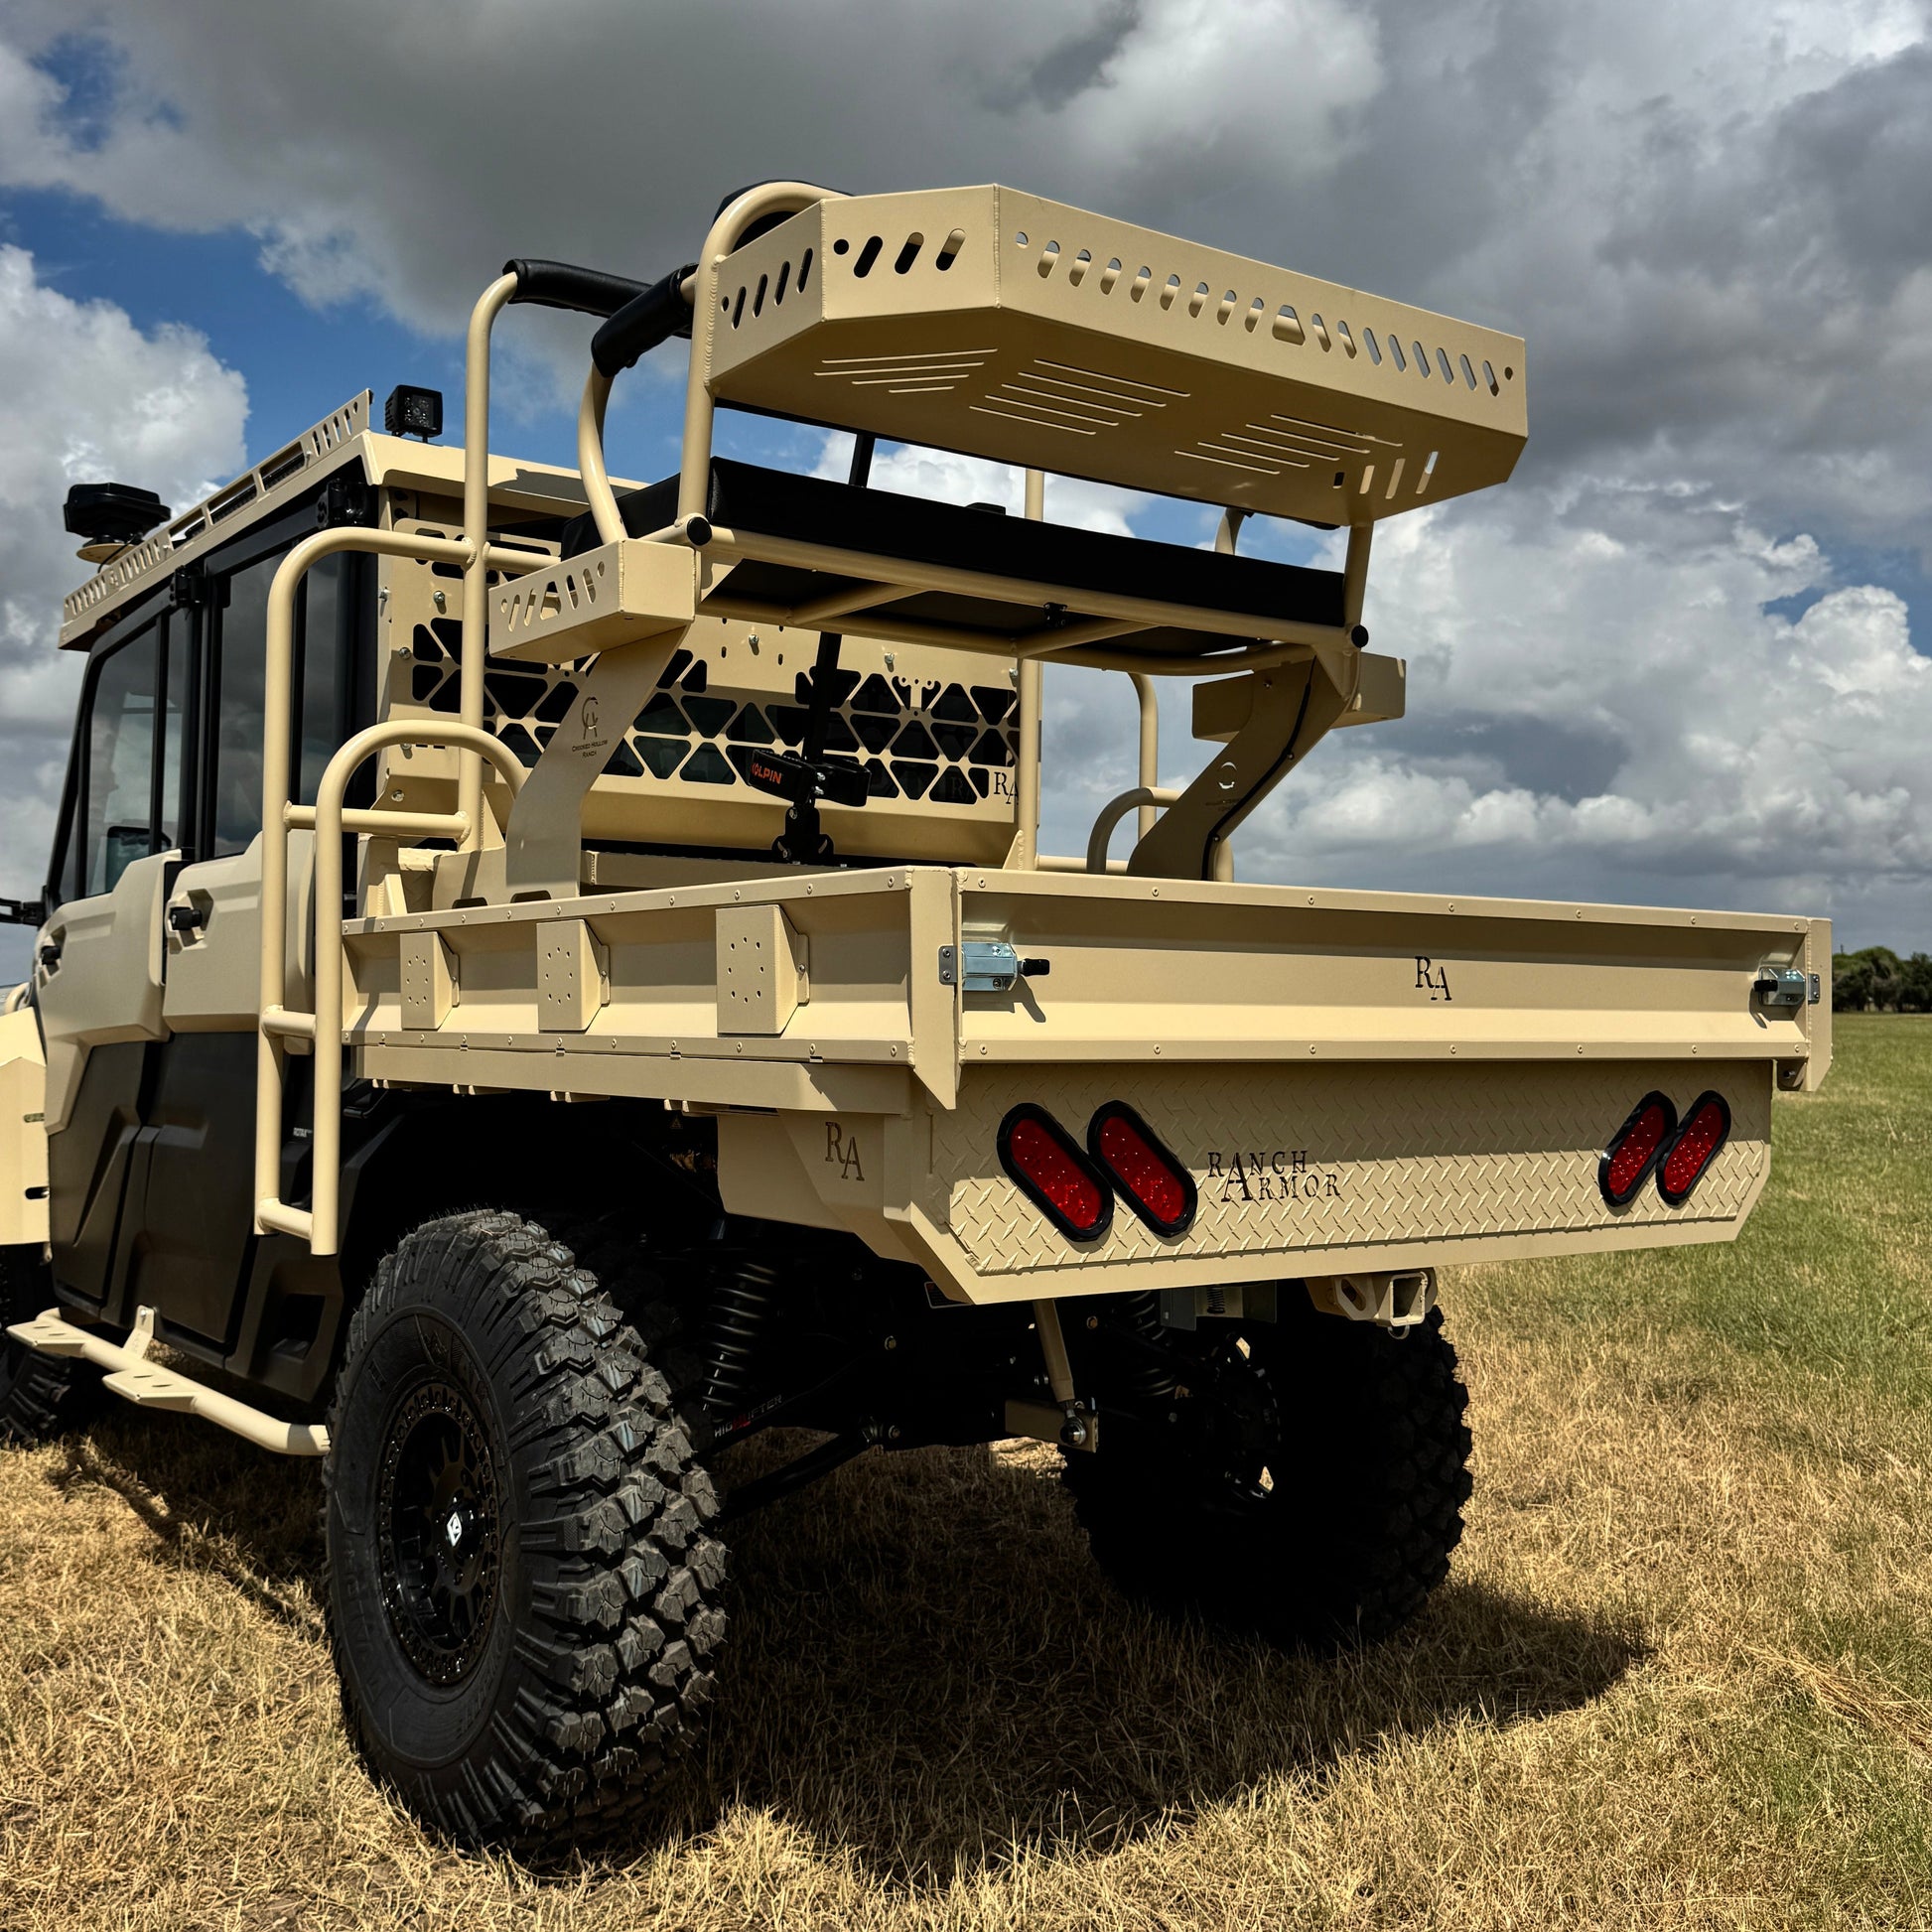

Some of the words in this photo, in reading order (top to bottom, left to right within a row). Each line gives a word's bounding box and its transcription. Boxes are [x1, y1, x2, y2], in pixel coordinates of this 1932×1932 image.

[1415, 956, 1452, 1001] RA
[825, 1121, 865, 1181] RA
[1207, 1151, 1308, 1178] RANCH
[1221, 1152, 1340, 1202] ARMOR
